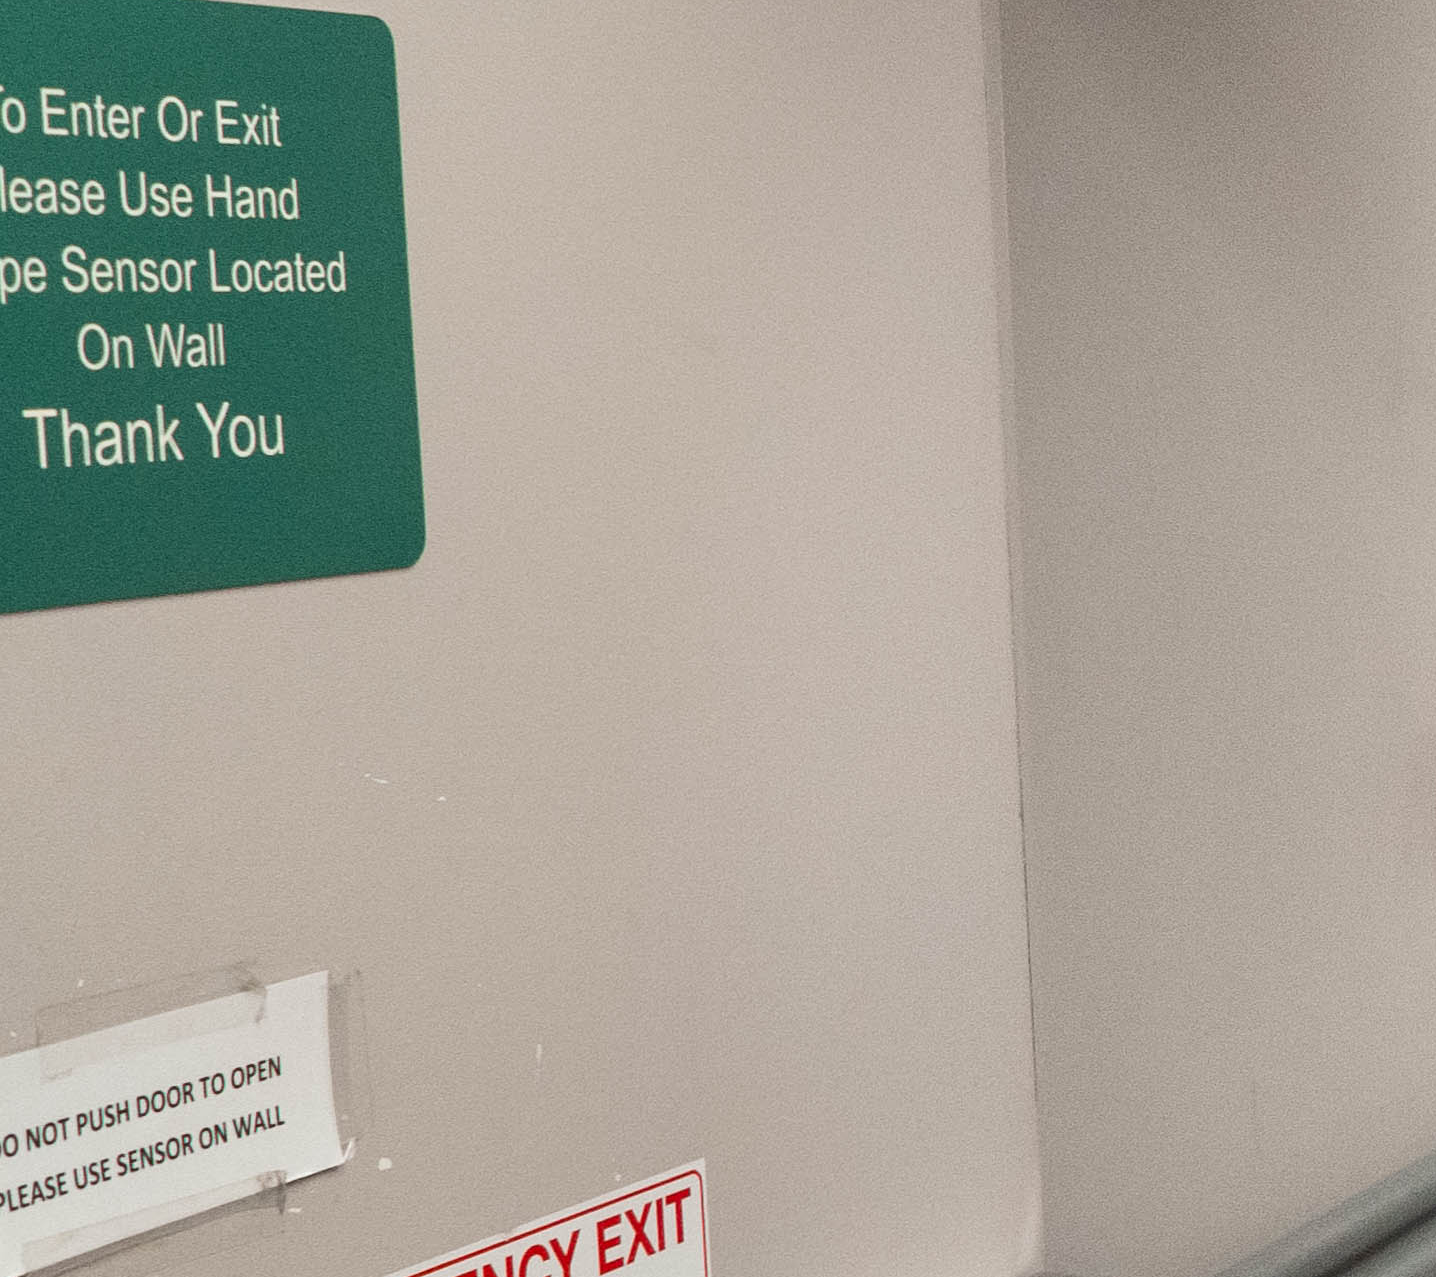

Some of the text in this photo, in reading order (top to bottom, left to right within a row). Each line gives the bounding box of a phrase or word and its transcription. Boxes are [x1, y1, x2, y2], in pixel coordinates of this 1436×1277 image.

[0, 85, 282, 147] o Enter Or Exit
[0, 165, 300, 219] lease Use Hand
[0, 245, 346, 305] pe Sensor Located
[77, 322, 226, 370] On Wall
[22, 401, 285, 469] Thank You
[0, 1055, 282, 1158] O NOT PUSH DOOR TO OPEN
[74, 1160, 111, 1191] USE
[116, 1133, 194, 1178] SENSOR
[199, 1125, 228, 1151] ON
[232, 1105, 285, 1139] WALL
[597, 1187, 692, 1275] EXIT
